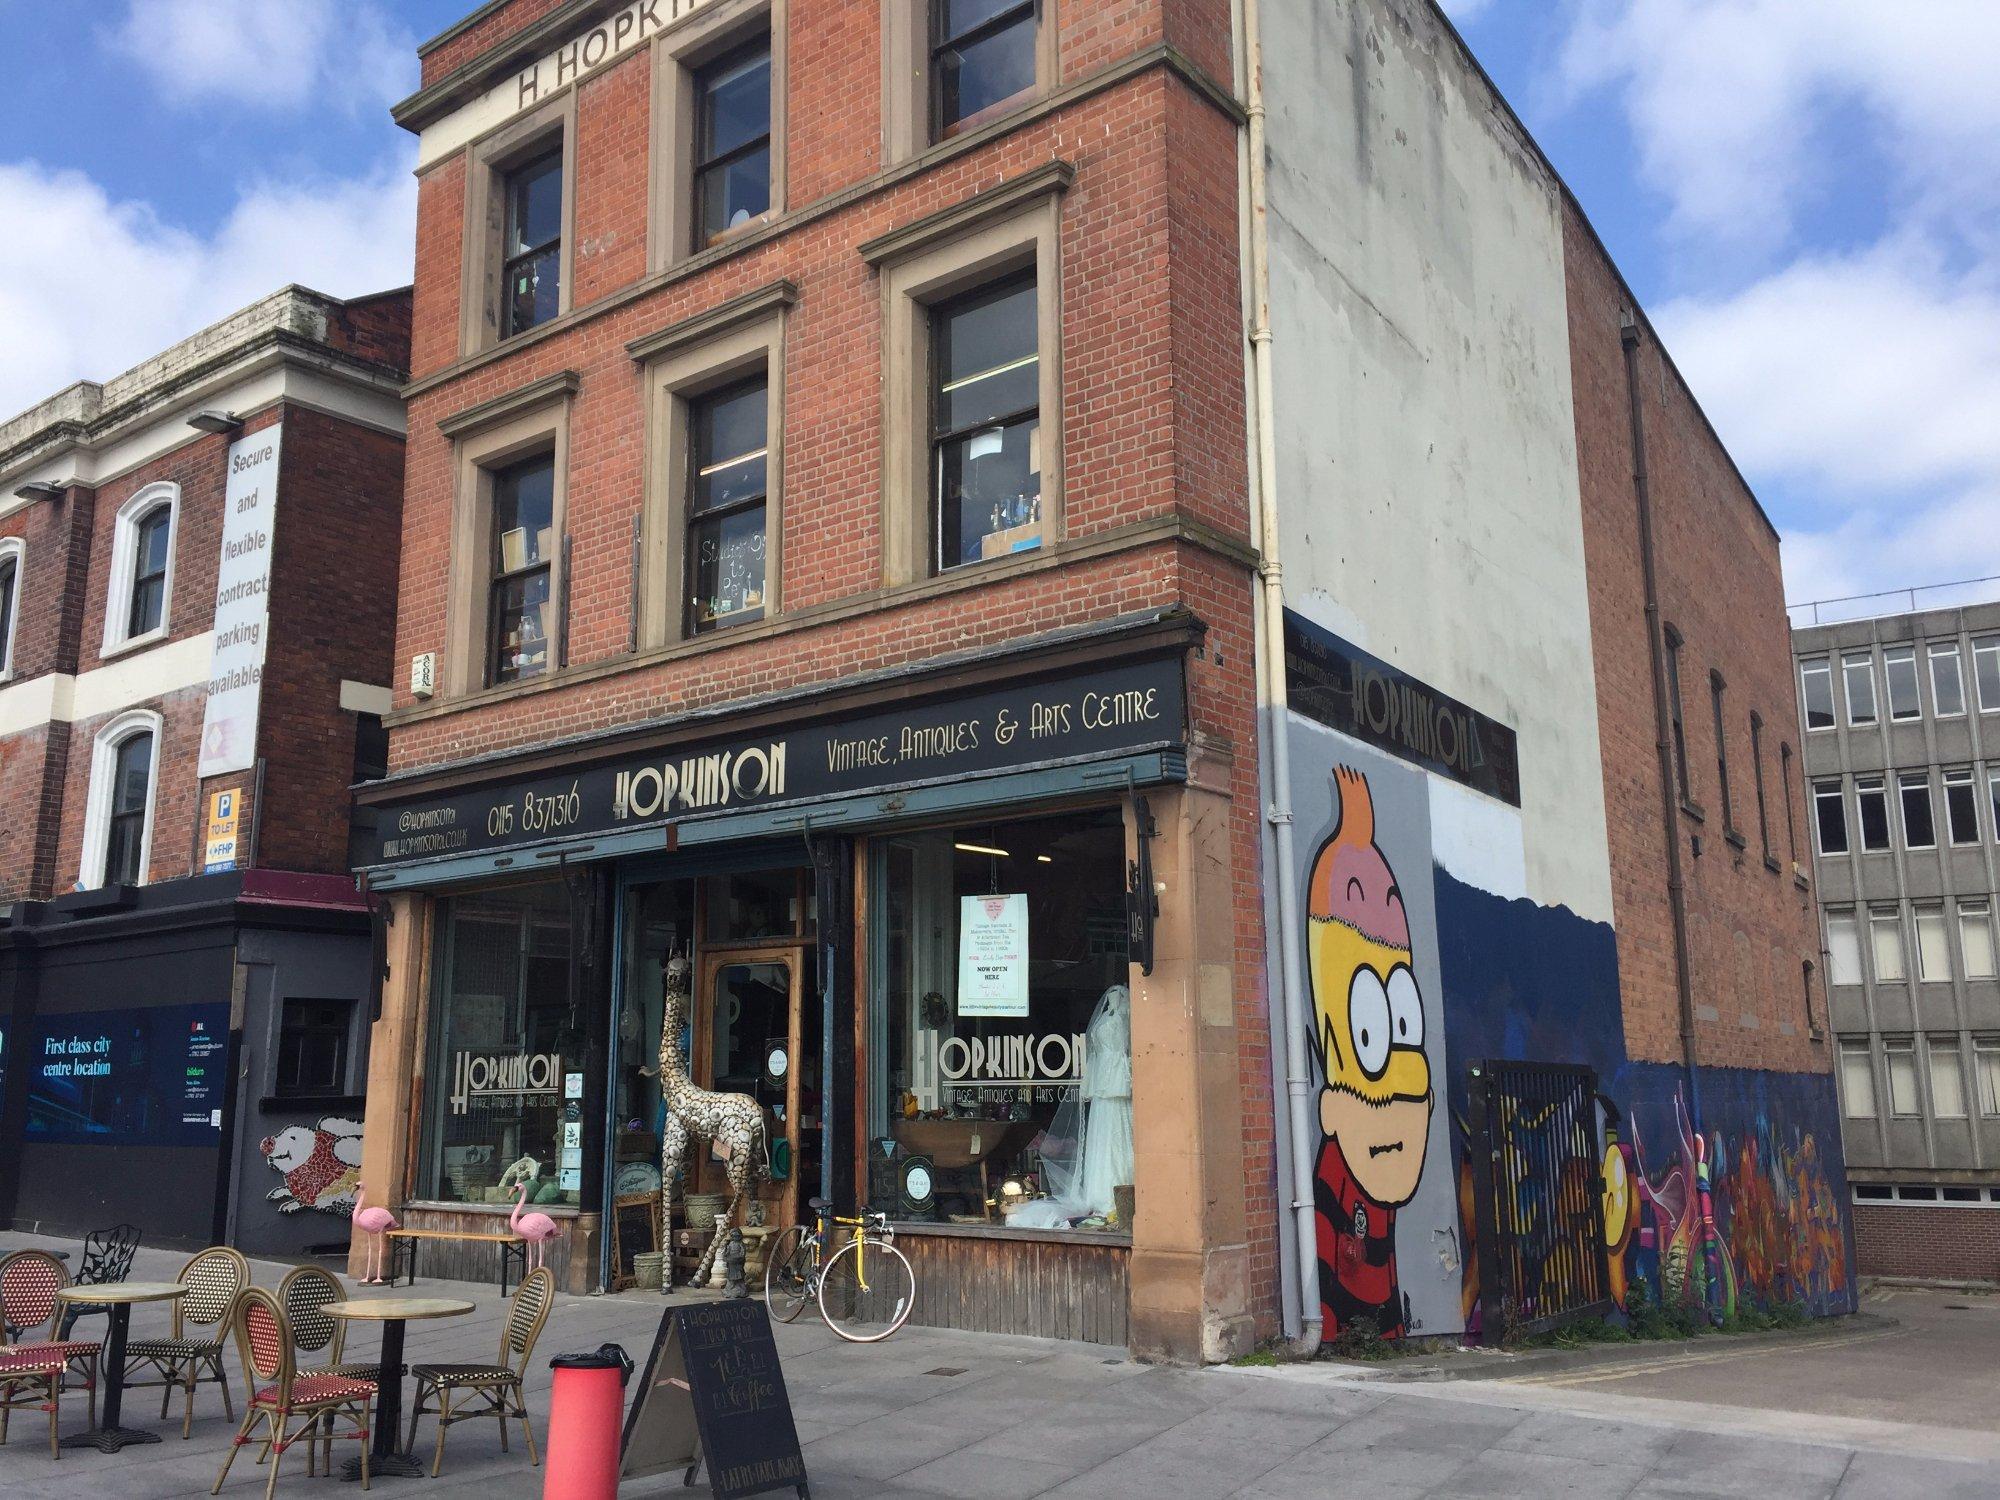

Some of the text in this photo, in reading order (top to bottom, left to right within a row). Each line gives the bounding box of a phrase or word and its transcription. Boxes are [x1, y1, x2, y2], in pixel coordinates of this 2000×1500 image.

[232, 444, 273, 475] Secure
[236, 487, 259, 514] and
[224, 529, 267, 562] flexible
[729, 560, 746, 579] to
[218, 572, 267, 607] contract
[216, 622, 260, 656] parking
[207, 664, 261, 697] available
[421, 654, 432, 686] ACORN
[1350, 659, 1470, 773] HOPKINSON
[612, 741, 787, 820] HOPKINSON
[899, 720, 980, 761] ANTIQUES
[995, 709, 1019, 745] &
[1029, 702, 1071, 739] ARTS
[1081, 688, 1160, 730] CENTRE
[487, 803, 514, 837] 0115
[522, 779, 580, 829] 8371316
[211, 821, 235, 836] TO LET
[218, 842, 233, 856] FHP
[45, 1035, 111, 1057] First class city
[43, 1057, 111, 1076] centre location
[910, 1028, 1088, 1111] HOPKINSON
[450, 1051, 560, 1115] HOPKINSON
[1036, 1086, 1053, 1103] ARTS
